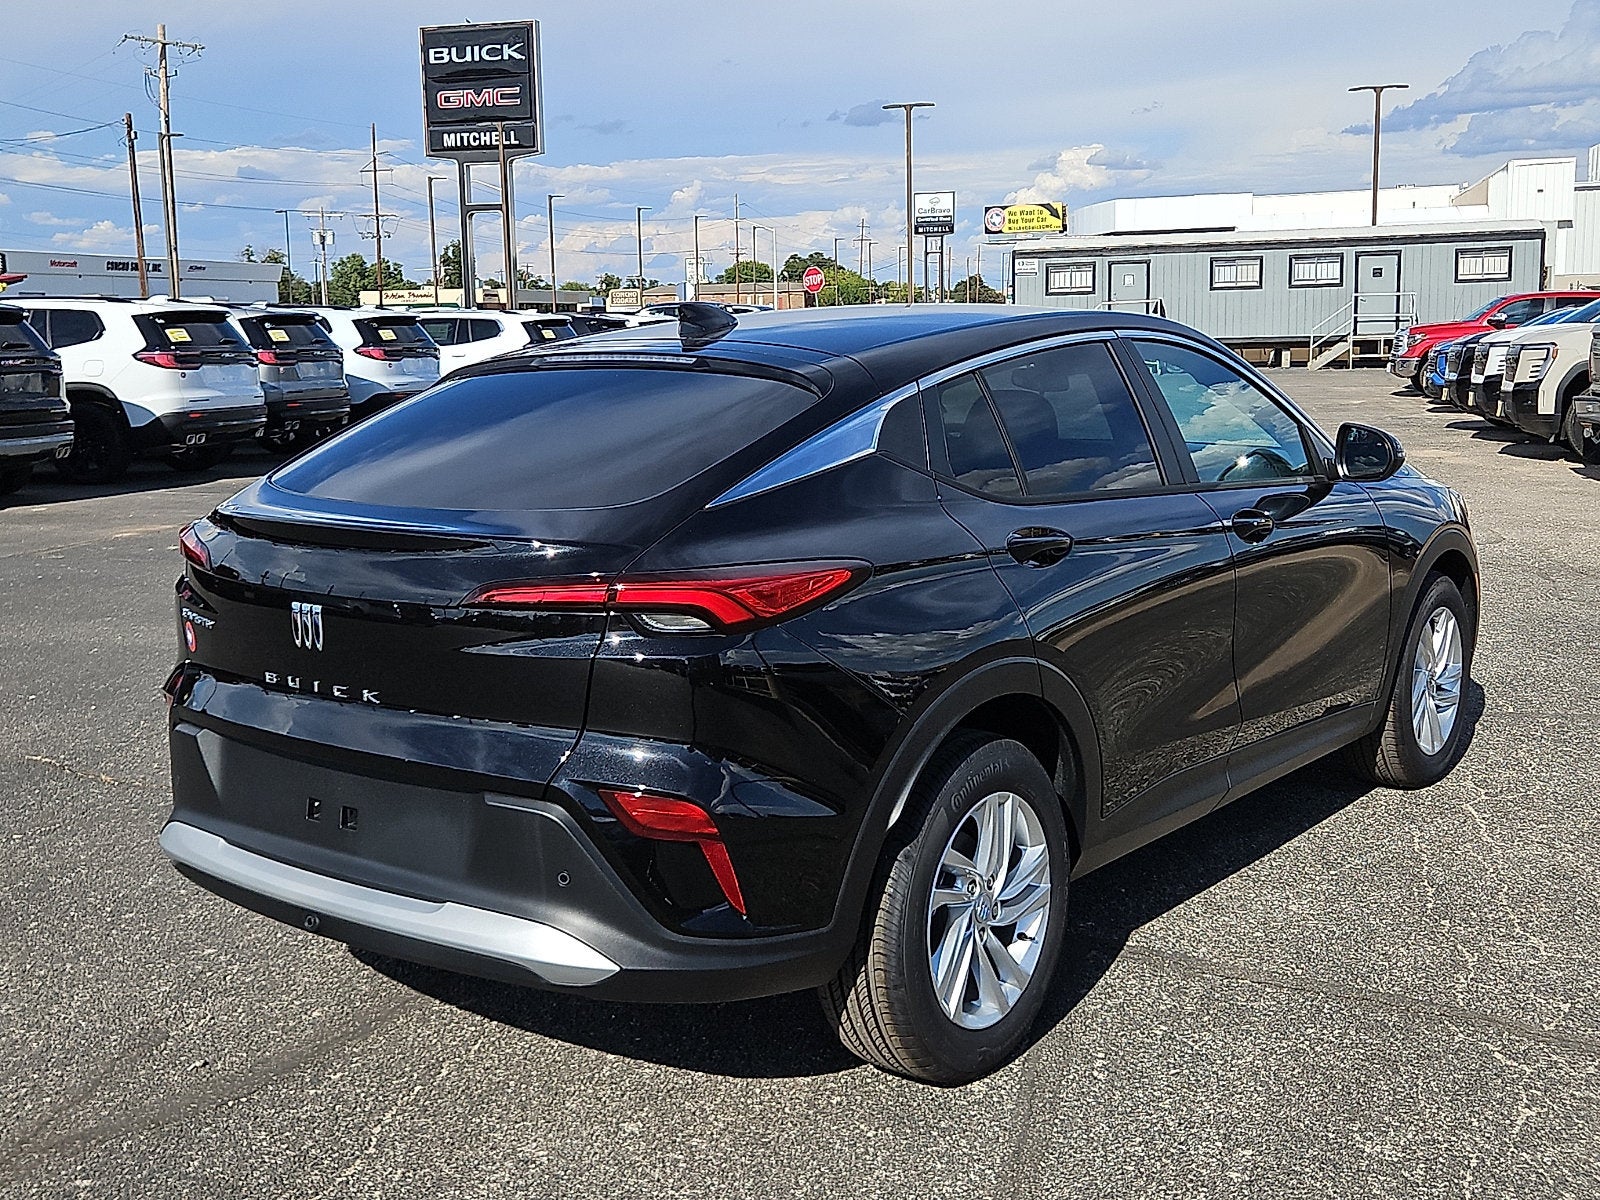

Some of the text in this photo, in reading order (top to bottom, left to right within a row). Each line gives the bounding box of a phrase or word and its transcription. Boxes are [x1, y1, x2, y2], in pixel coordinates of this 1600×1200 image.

[428, 42, 526, 64] BUICK
[437, 86, 521, 109] GMC
[443, 130, 520, 147] MITCHELL
[804, 273, 822, 286] STOP
[264, 671, 381, 704] BUICK
[951, 758, 1004, 813] Continental
